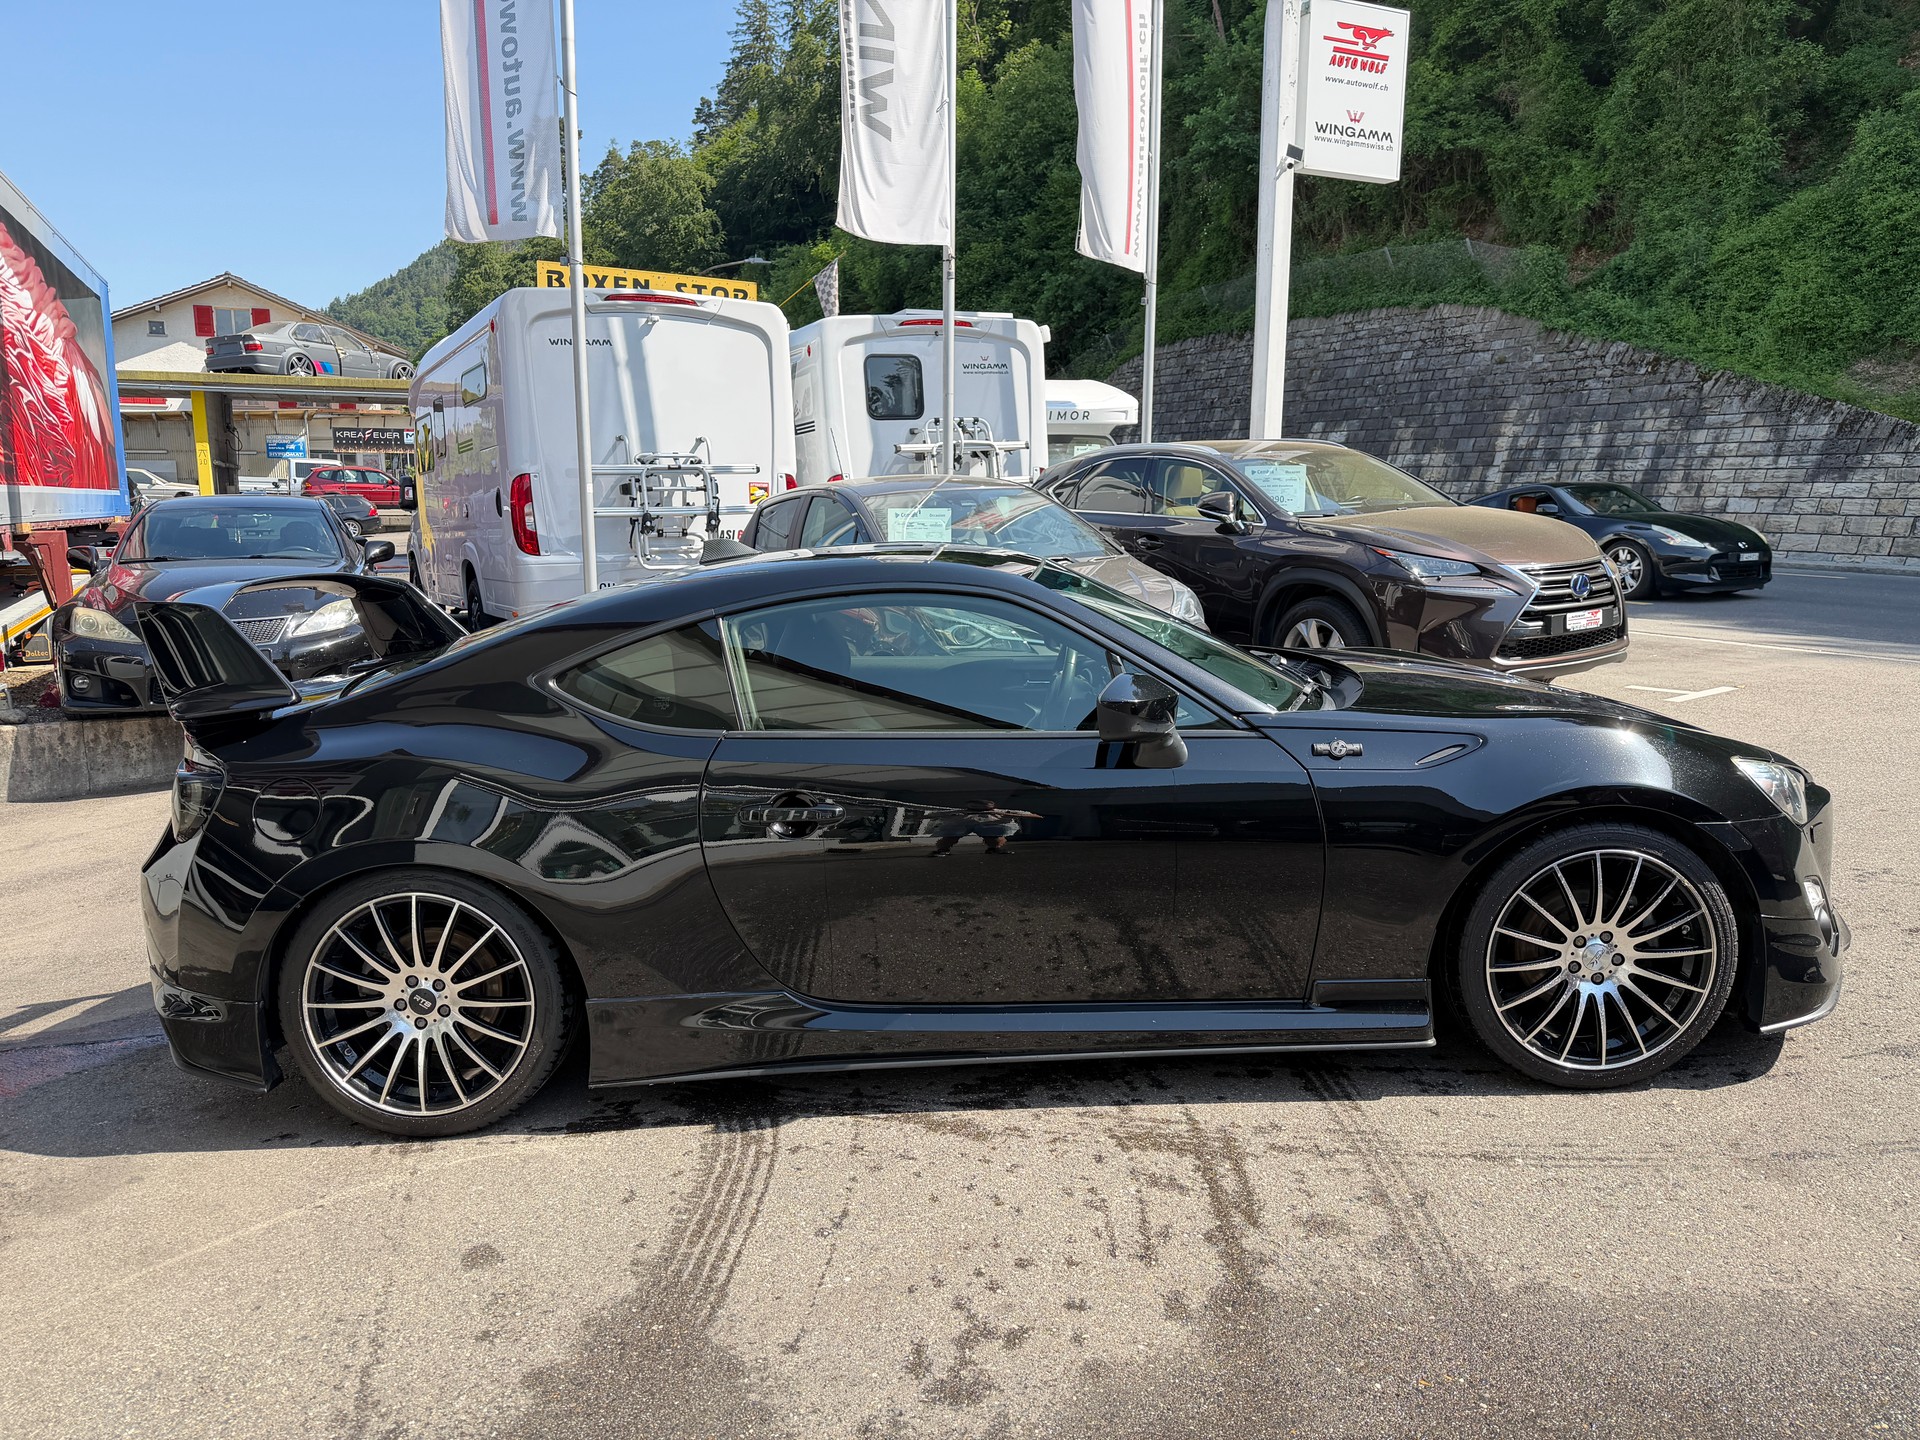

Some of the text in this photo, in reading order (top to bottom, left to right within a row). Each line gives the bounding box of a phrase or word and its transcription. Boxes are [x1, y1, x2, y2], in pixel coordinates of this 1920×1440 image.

[1328, 54, 1388, 74] AUTO WOLF
[1325, 75, 1389, 92] www.autowolf.ch
[1315, 121, 1393, 144] WINGAMM
[1314, 134, 1394, 152] www.wingammswiss.ch
[548, 338, 613, 347] WINAMM
